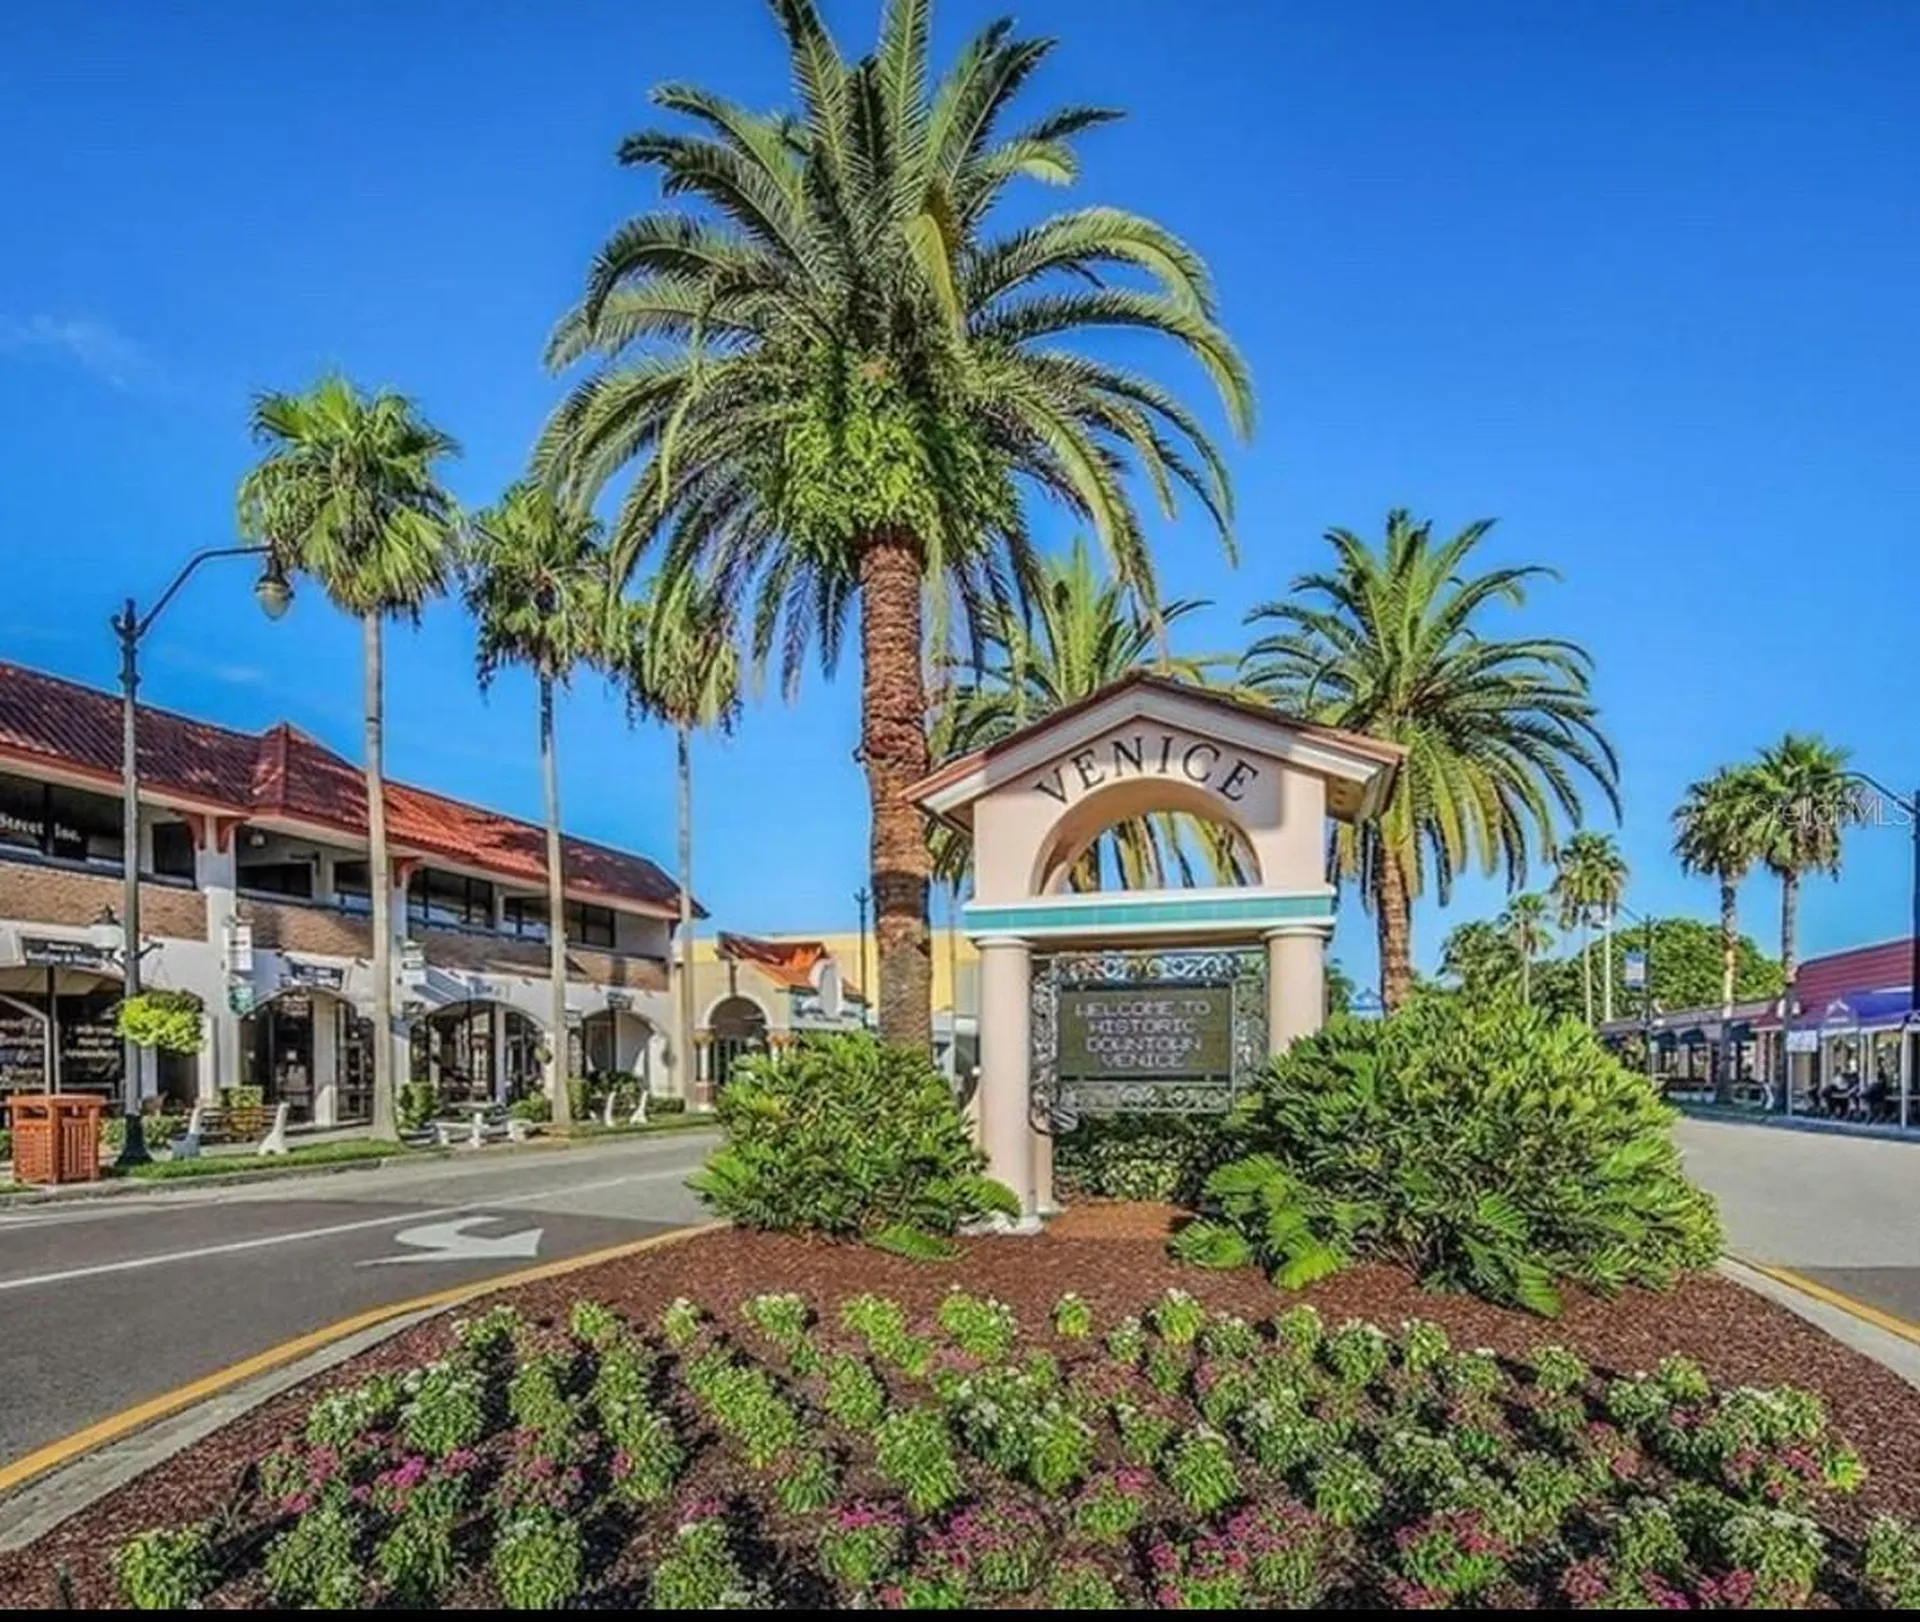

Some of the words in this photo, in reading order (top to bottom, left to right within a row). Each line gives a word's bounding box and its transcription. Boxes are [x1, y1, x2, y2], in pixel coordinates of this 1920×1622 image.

[1033, 736, 1259, 805] VENICE
[1075, 1001, 1174, 1016] WELCOME
[1182, 1001, 1211, 1016] TO
[1088, 1018, 1197, 1033] HISTORIC
[1086, 1037, 1202, 1053] DOWNTOWN
[1102, 1052, 1185, 1067] VENICE
